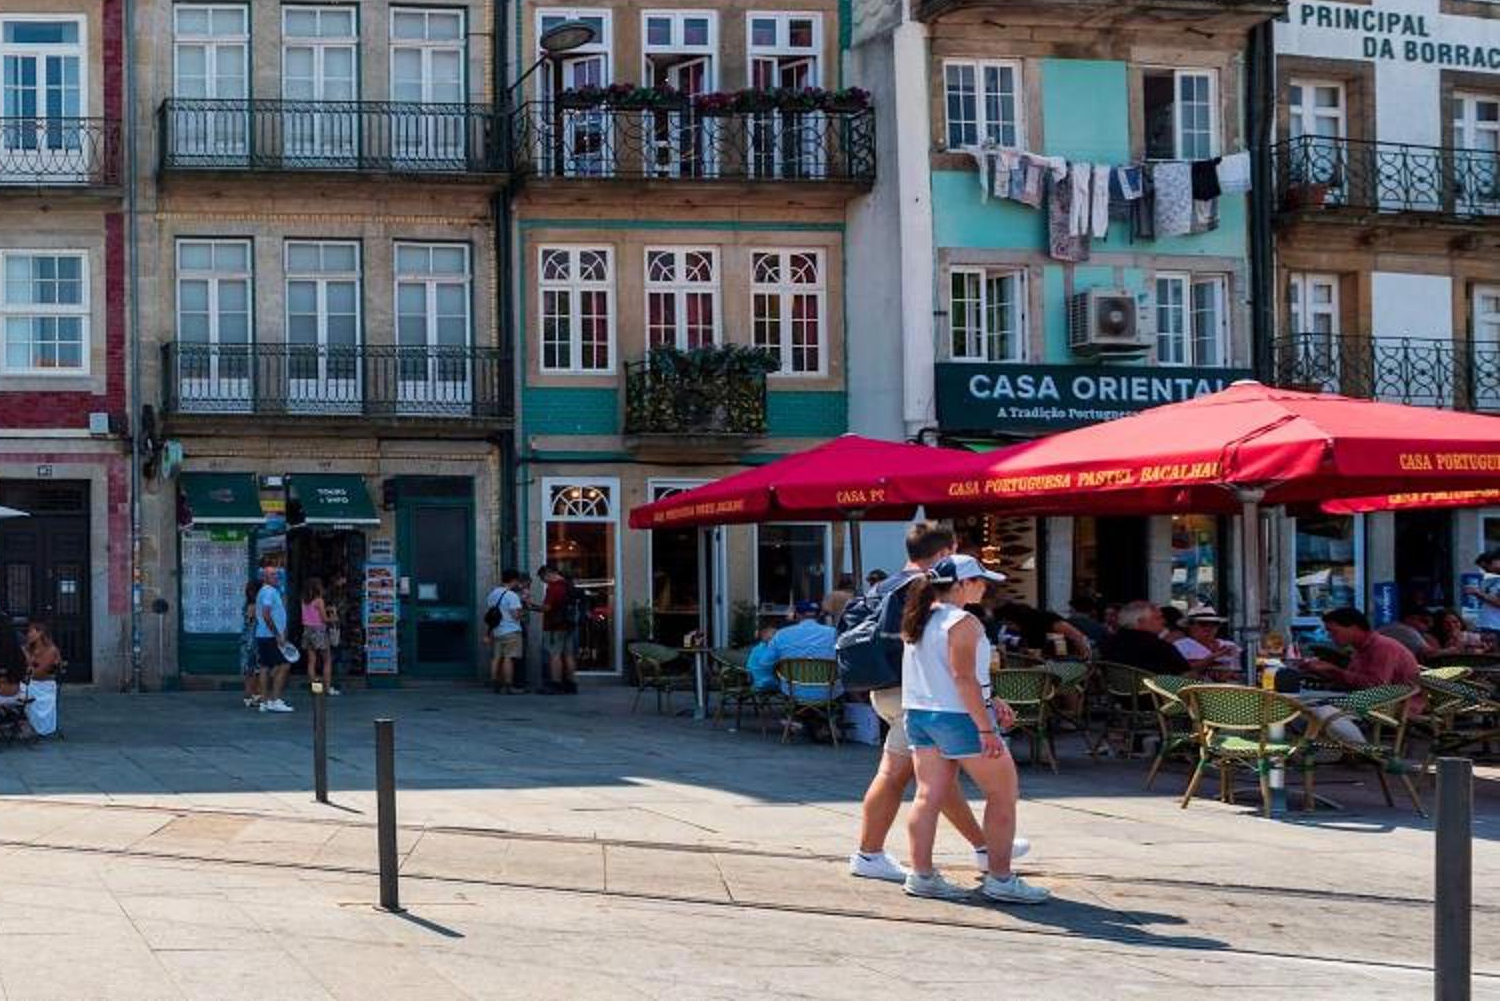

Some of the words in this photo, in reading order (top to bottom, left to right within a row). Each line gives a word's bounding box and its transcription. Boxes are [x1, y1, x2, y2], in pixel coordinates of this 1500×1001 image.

[1301, 4, 1430, 37] PRINCIPAL
[1363, 37, 1395, 60] DA
[1404, 40, 1500, 69] BORRAC
[969, 374, 1060, 400] CASA
[997, 407, 1008, 418] A
[1009, 406, 1066, 420] Tradição
[1399, 453, 1432, 470] CASA
[949, 481, 979, 496] CASA
[984, 474, 1071, 494] PORTUGUESA
[1078, 469, 1133, 487] PASTEL
[1140, 462, 1221, 482] BACALHAU
[836, 489, 867, 503] CASA
